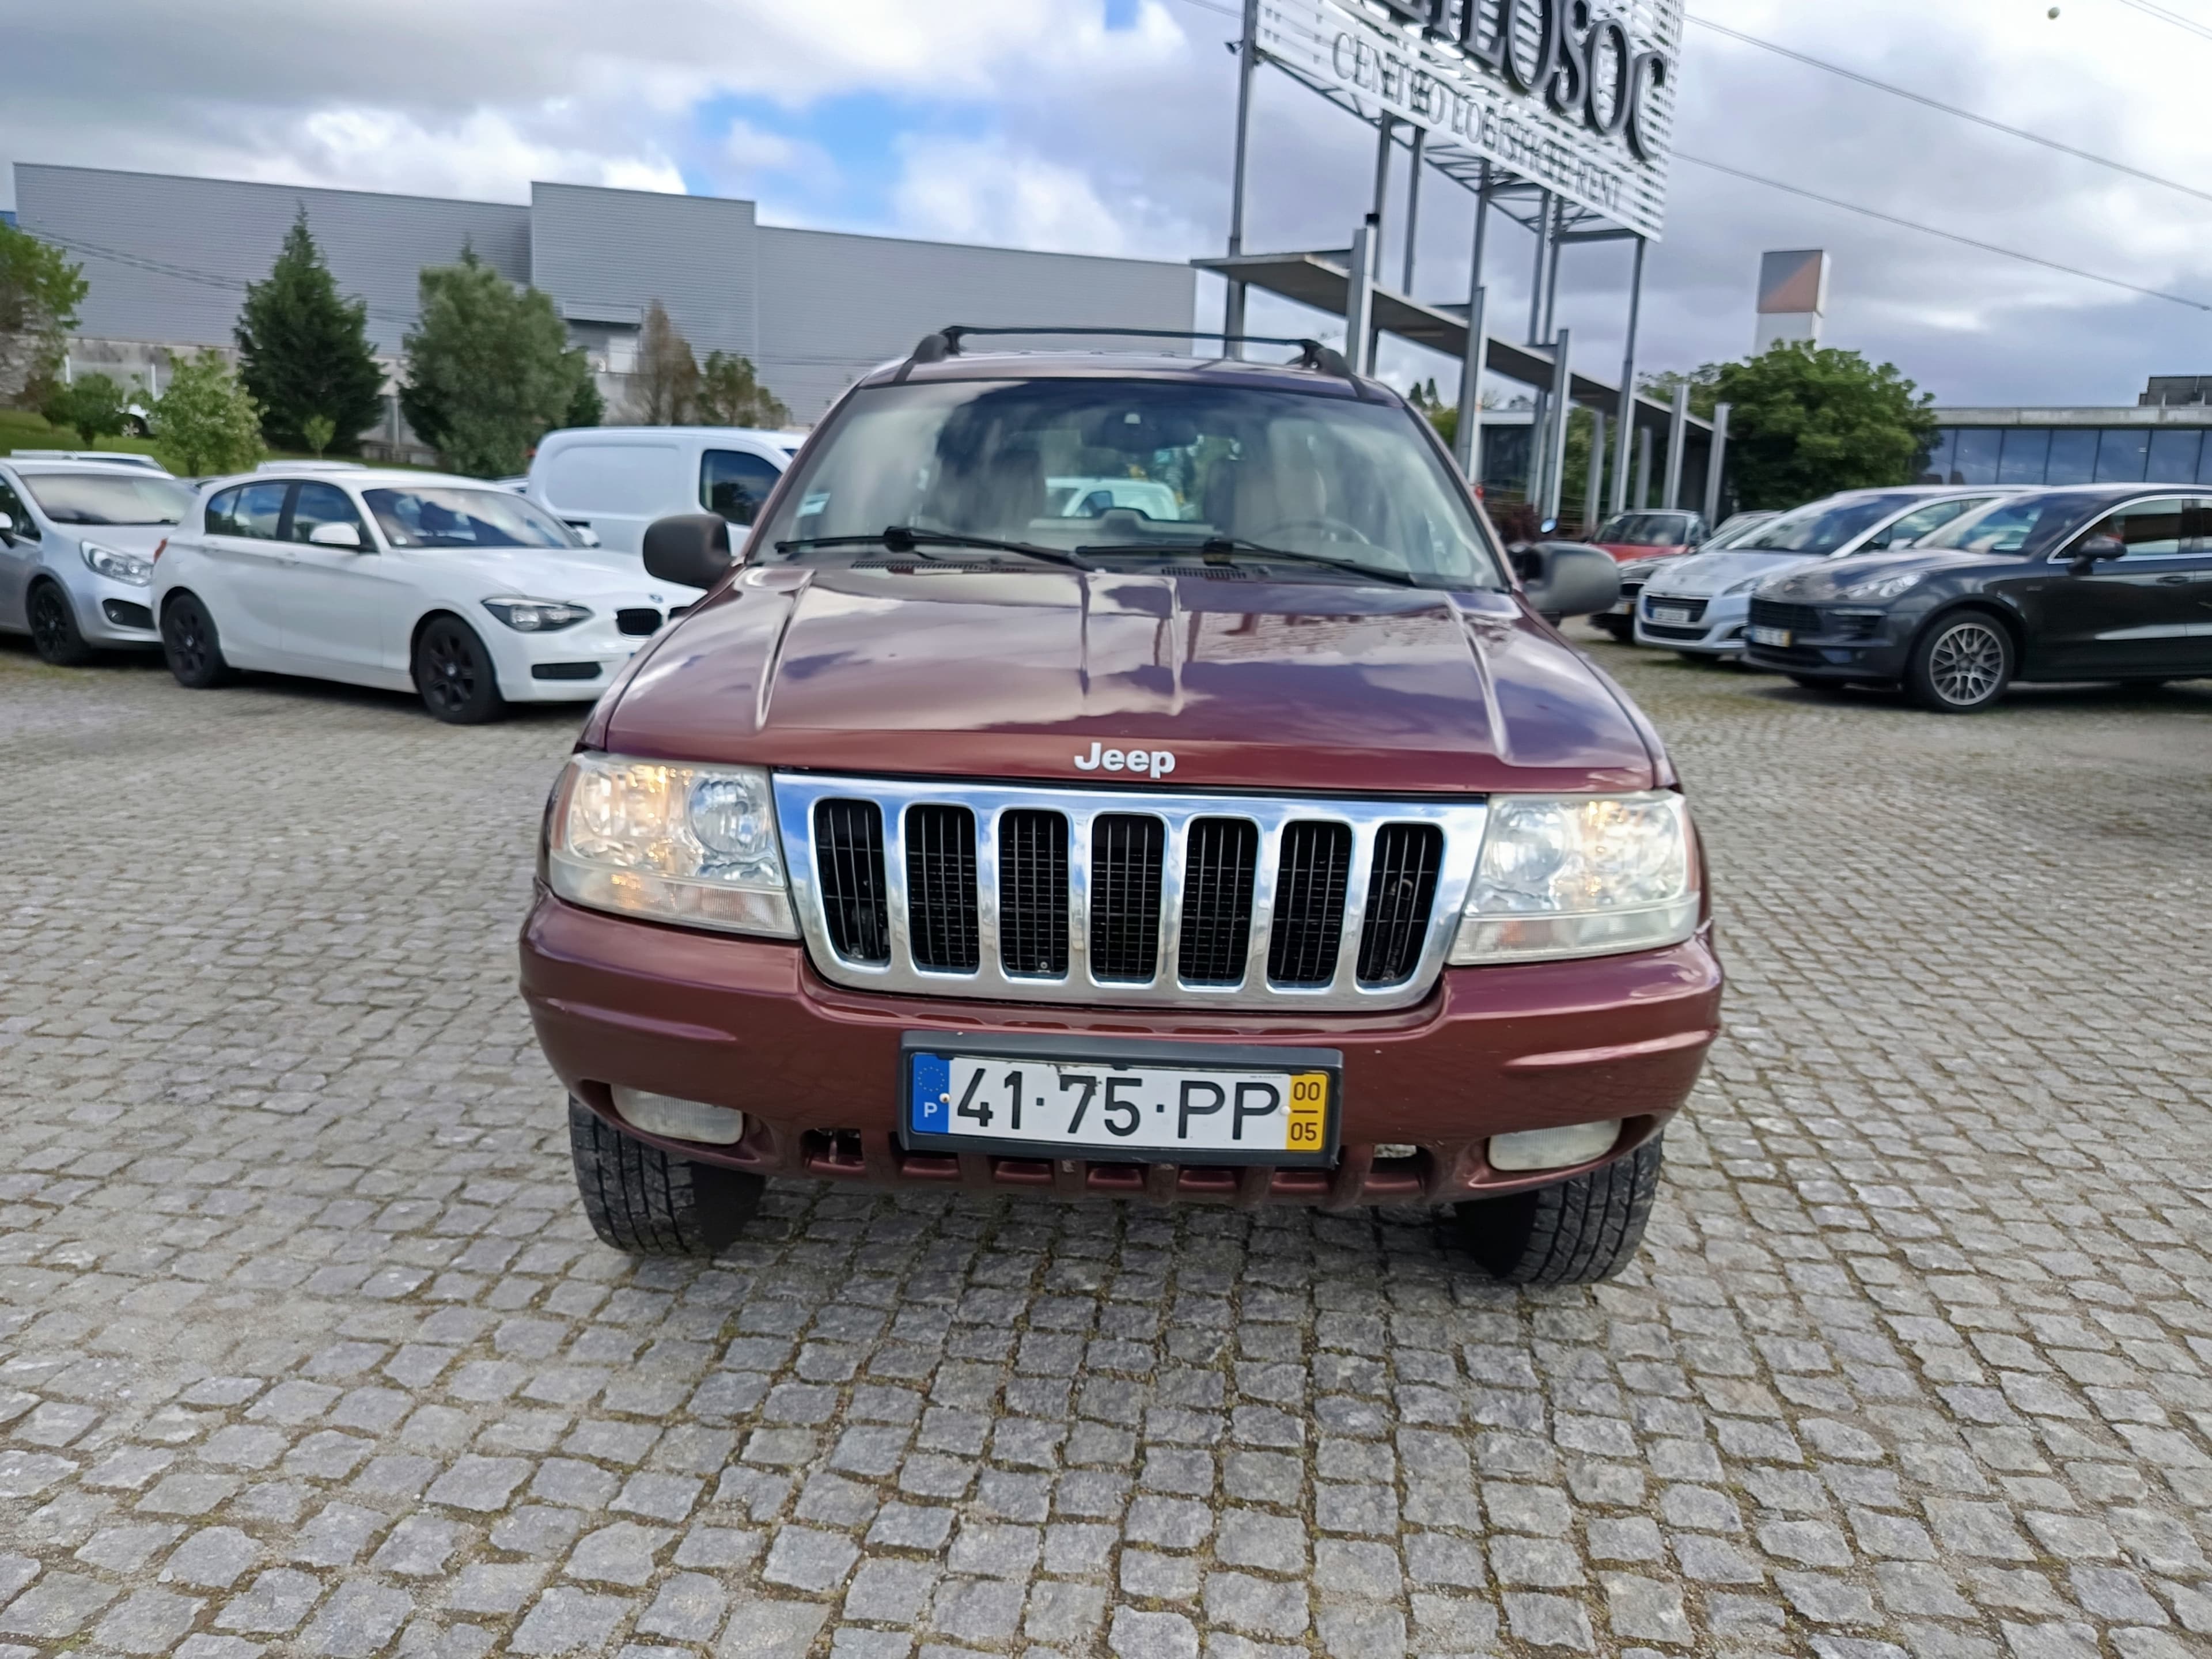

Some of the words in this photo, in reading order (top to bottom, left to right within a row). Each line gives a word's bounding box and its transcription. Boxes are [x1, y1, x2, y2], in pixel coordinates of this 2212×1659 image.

[1074, 741, 1176, 779] Jeep
[1293, 1081, 1321, 1101] 00
[923, 1101, 938, 1118] P
[1290, 1122, 1317, 1141] 05
